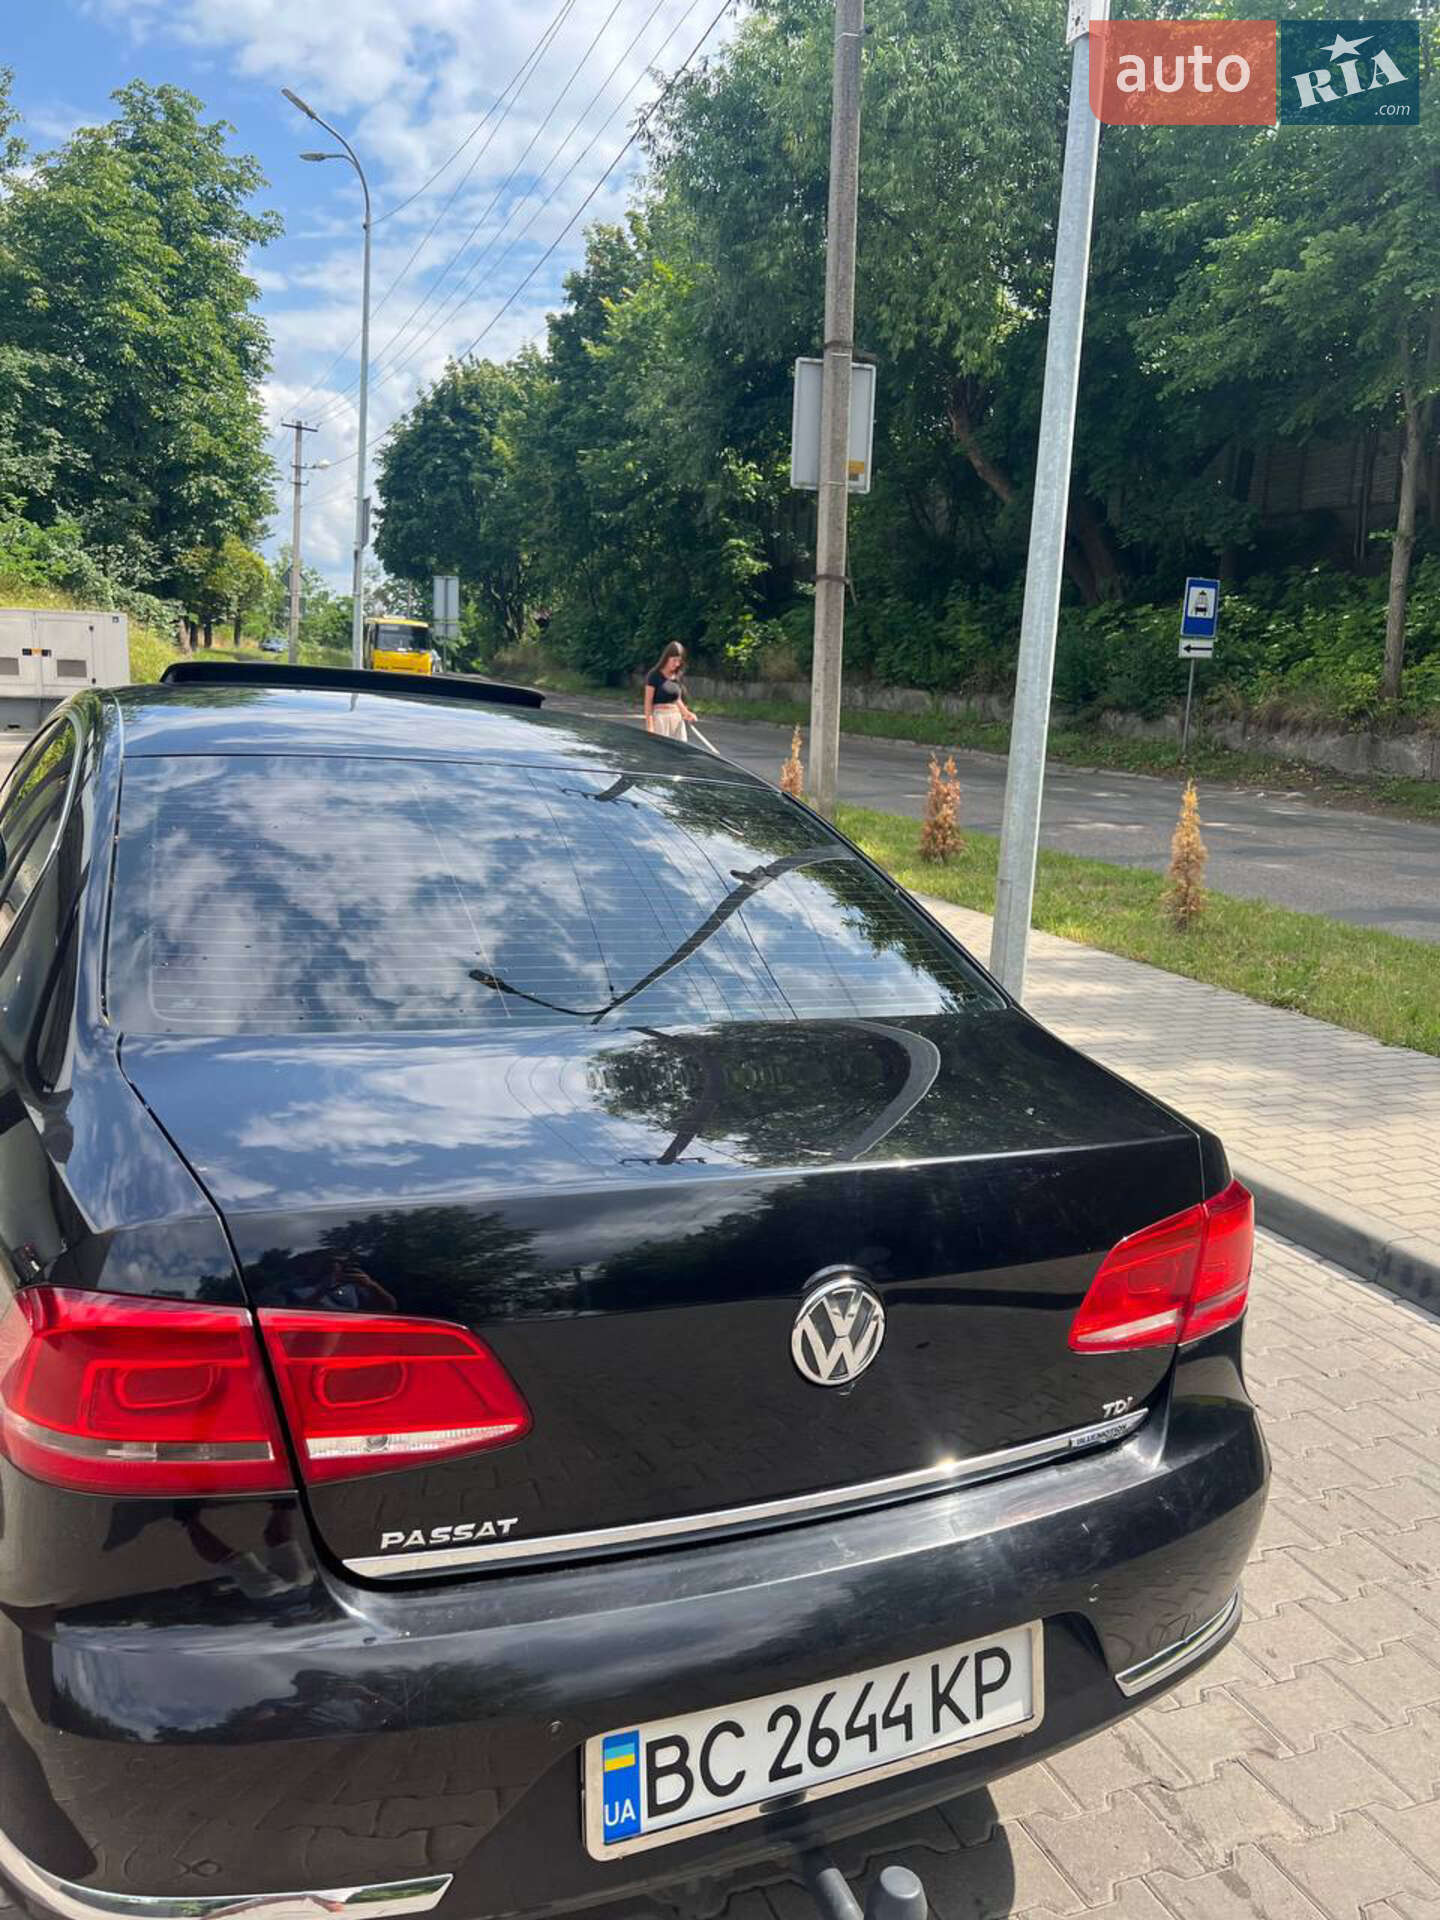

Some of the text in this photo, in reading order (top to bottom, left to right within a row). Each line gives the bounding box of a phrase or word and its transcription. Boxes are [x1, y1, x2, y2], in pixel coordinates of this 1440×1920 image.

[380, 1517, 519, 1550] PASSAT
[646, 1646, 1012, 1818] BC 2644 KP
[604, 1799, 637, 1826] UA
